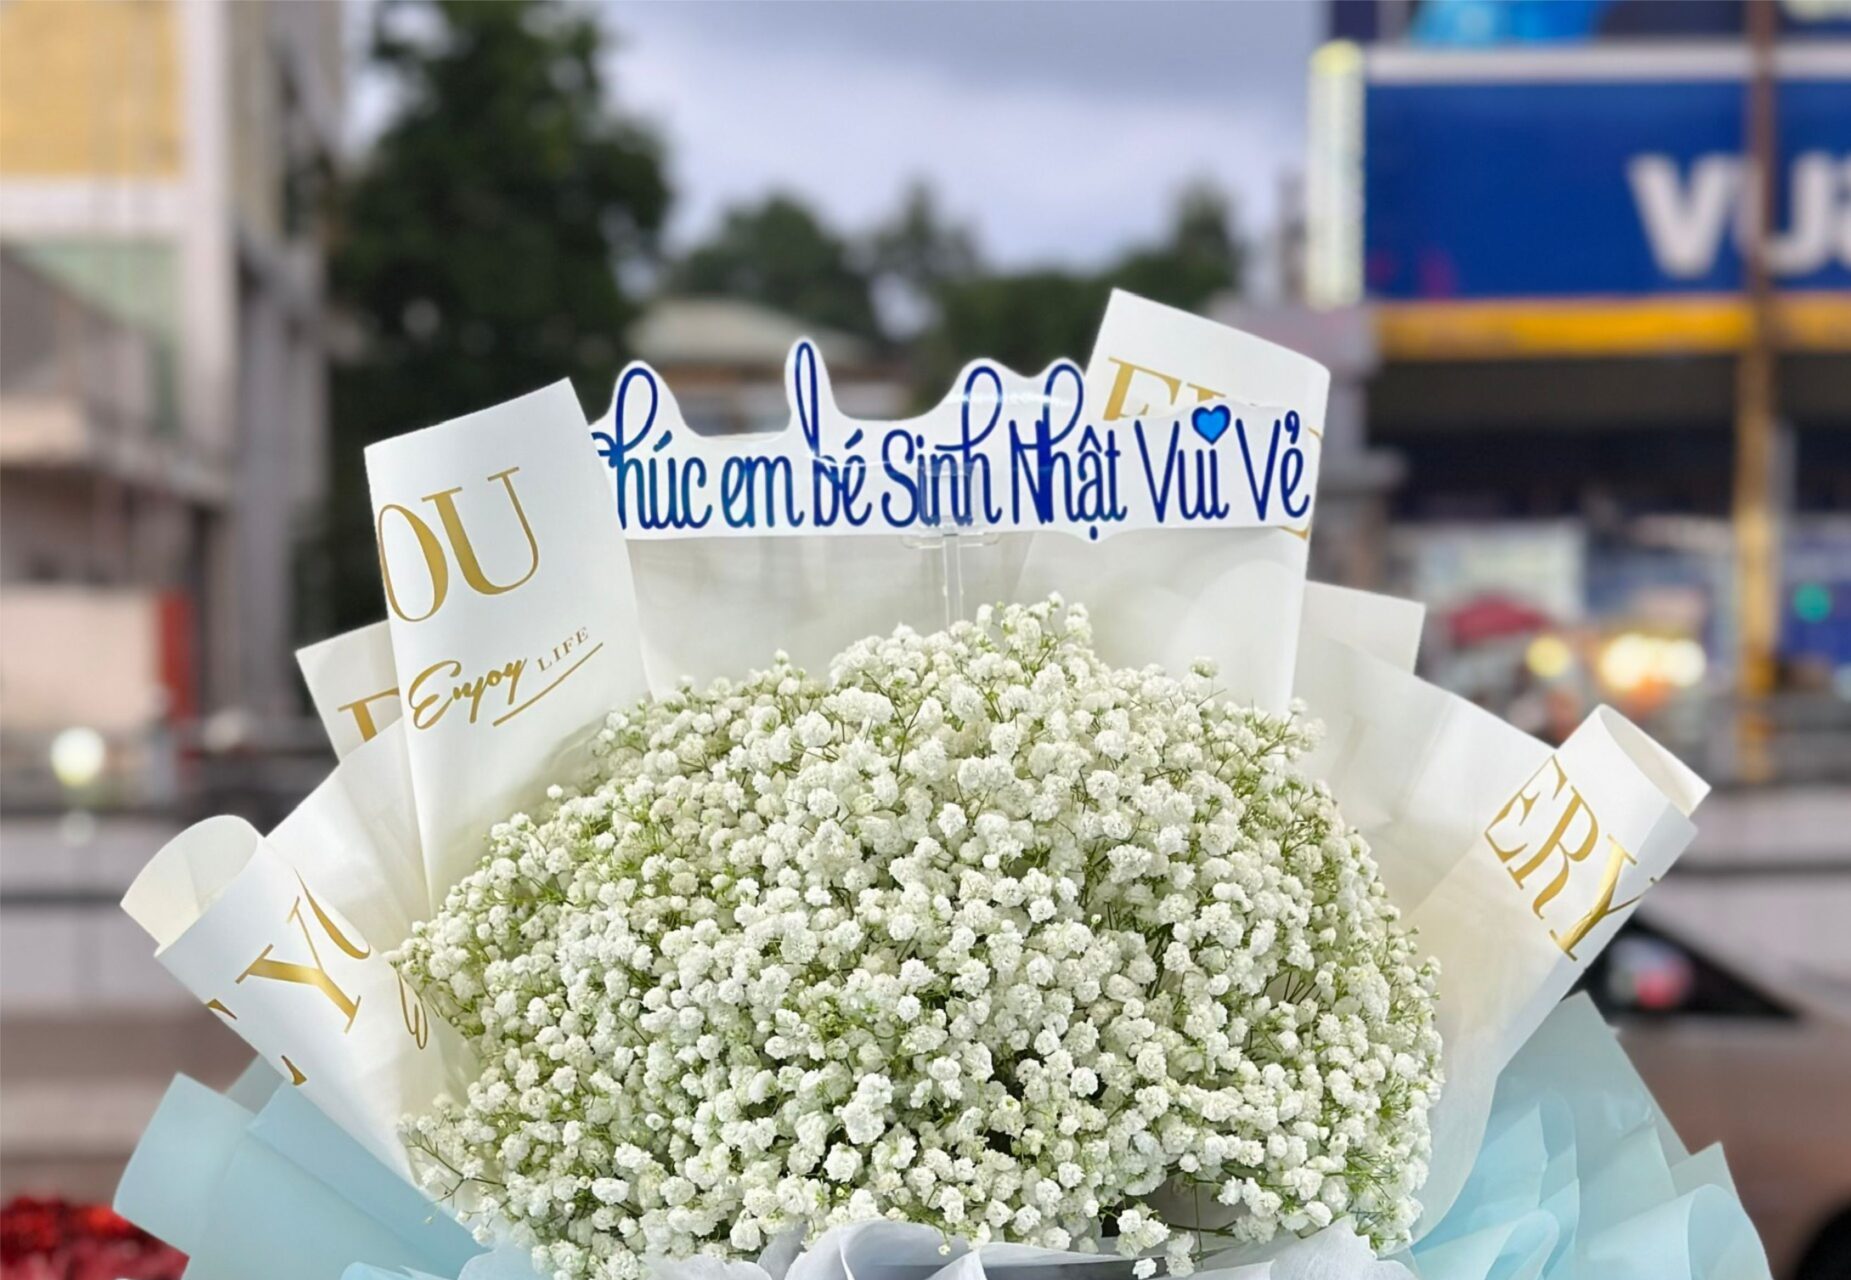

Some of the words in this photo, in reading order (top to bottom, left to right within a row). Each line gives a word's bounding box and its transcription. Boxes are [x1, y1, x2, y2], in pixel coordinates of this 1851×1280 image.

[721, 455, 804, 529] em
[795, 341, 872, 527] bé
[881, 365, 1003, 527] Sinh
[1009, 363, 1128, 541] Nhật
[1134, 404, 1231, 523] Vui
[1235, 410, 1311, 521] Vẻ
[408, 657, 528, 730] Enjoy
[536, 626, 590, 673] LIFE
